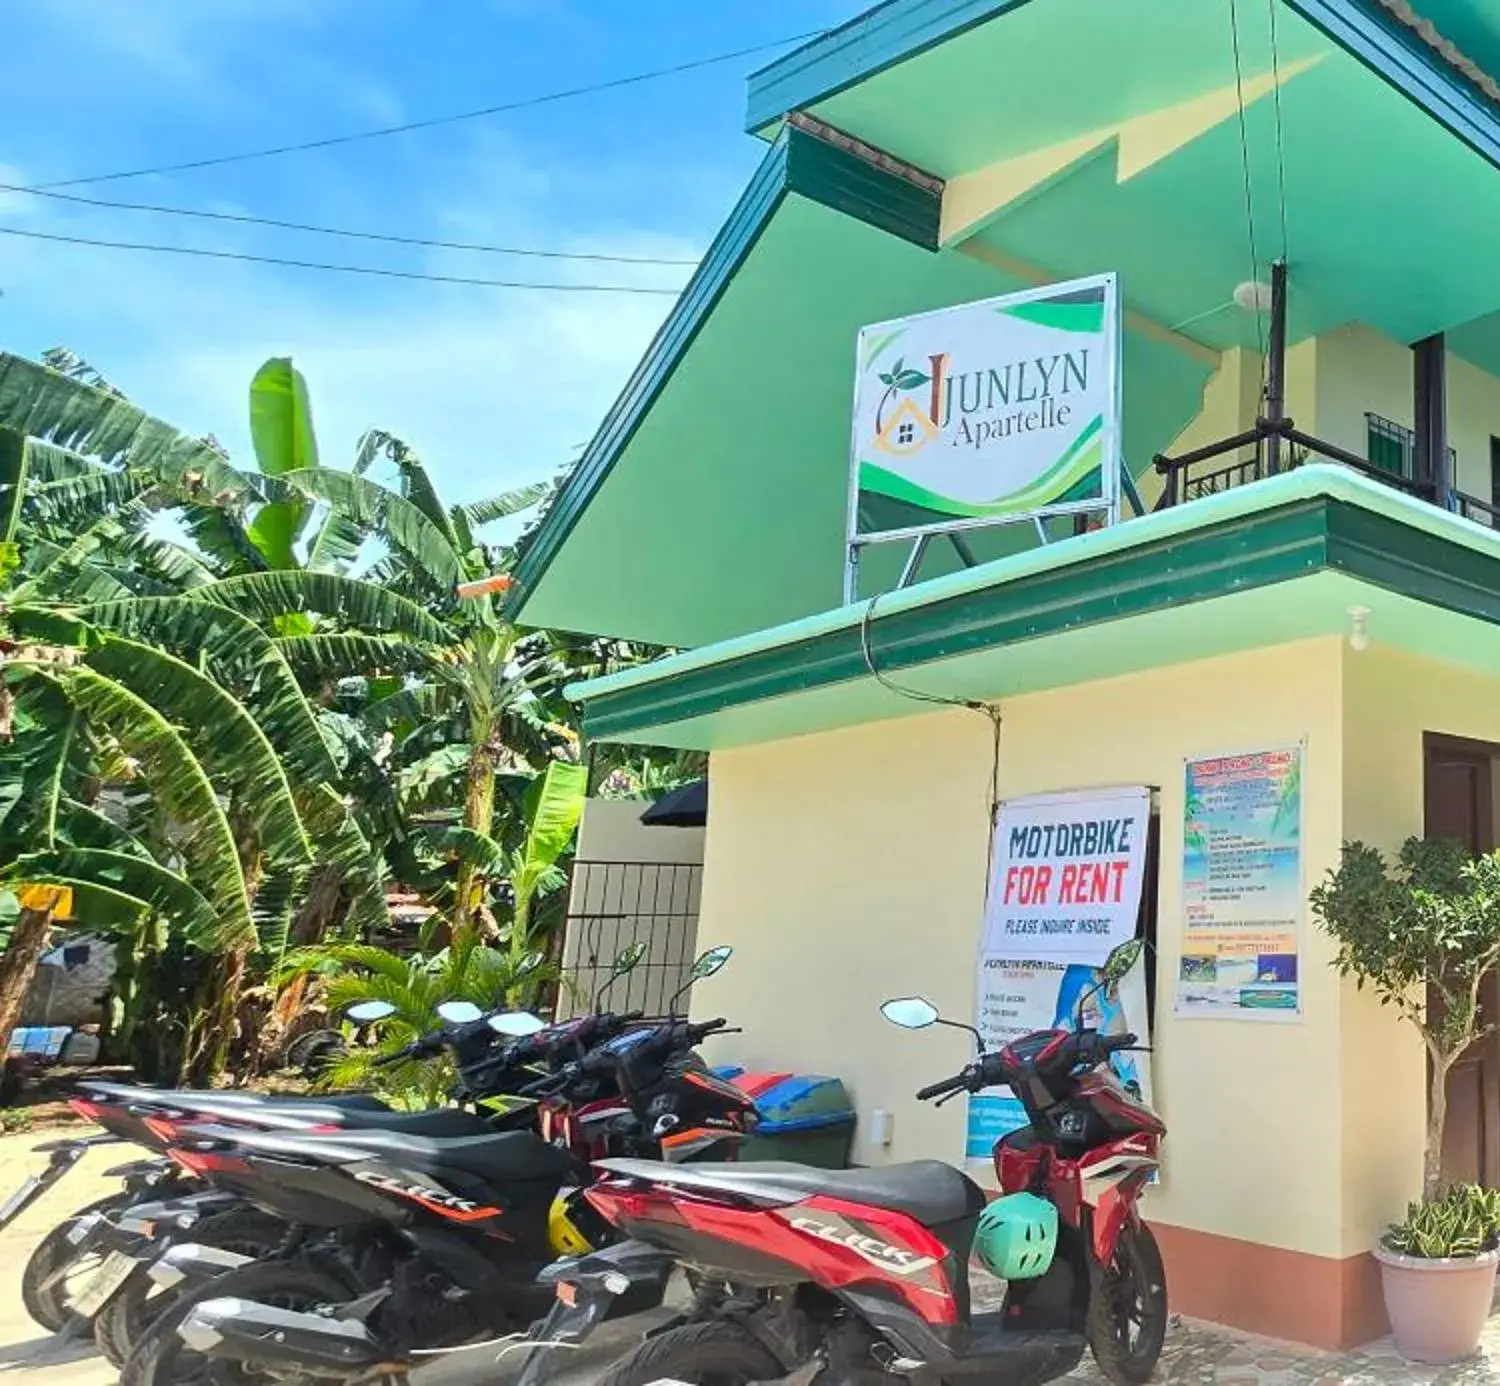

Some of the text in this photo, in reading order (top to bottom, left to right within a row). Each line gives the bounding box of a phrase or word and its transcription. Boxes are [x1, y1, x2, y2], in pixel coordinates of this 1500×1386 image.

[942, 349, 1089, 429] JUNLYN
[952, 397, 1072, 449] Apartelle
[1009, 817, 1135, 859] MOTORBIKE
[1003, 861, 1129, 905] FOR RENT
[1006, 918, 1111, 935] PLEASE INQUIRE INSIDE
[790, 1217, 914, 1266] CLICK
